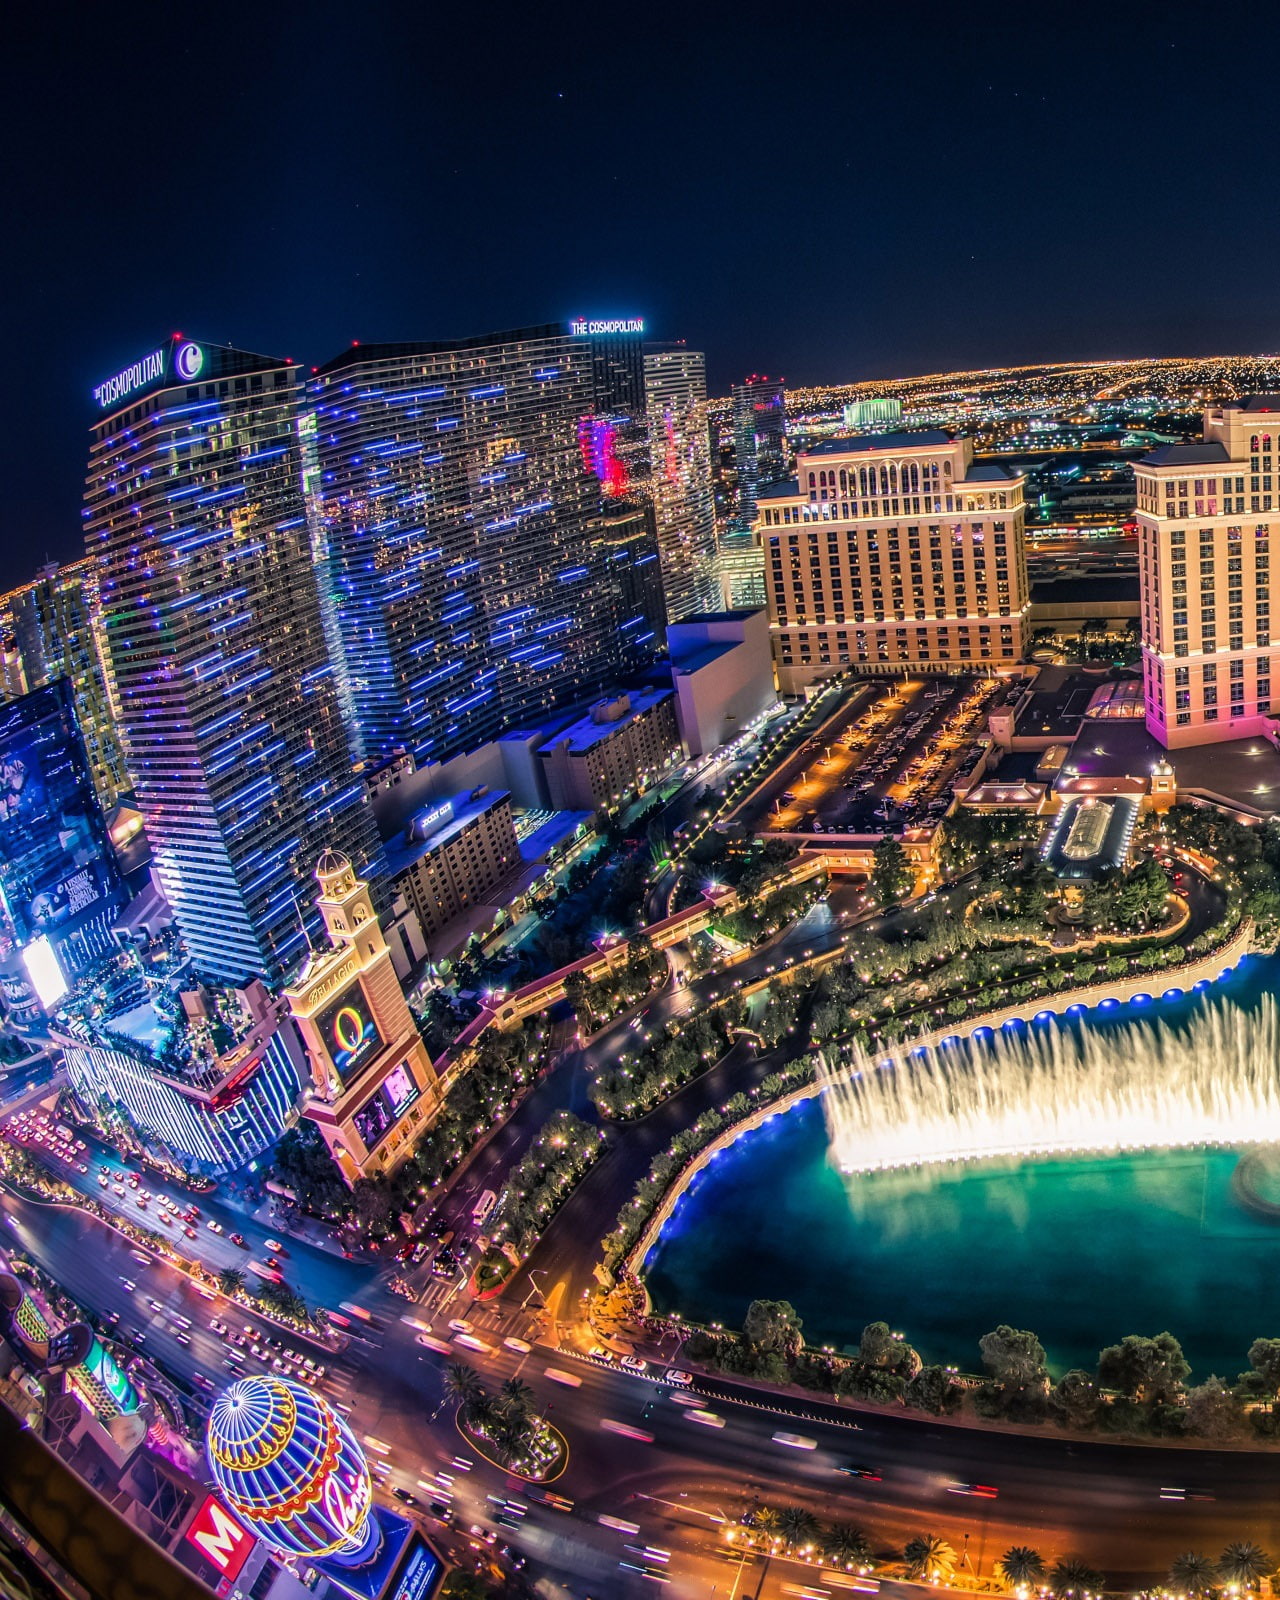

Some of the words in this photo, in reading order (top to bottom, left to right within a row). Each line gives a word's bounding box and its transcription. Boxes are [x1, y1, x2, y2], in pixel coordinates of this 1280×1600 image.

[571, 322, 587, 335] THE
[589, 320, 643, 334] COSMOPOLITAN
[101, 350, 163, 407] COSMOPOLITAN
[308, 960, 356, 1006] BELLAGIO
[194, 1503, 244, 1569] M
